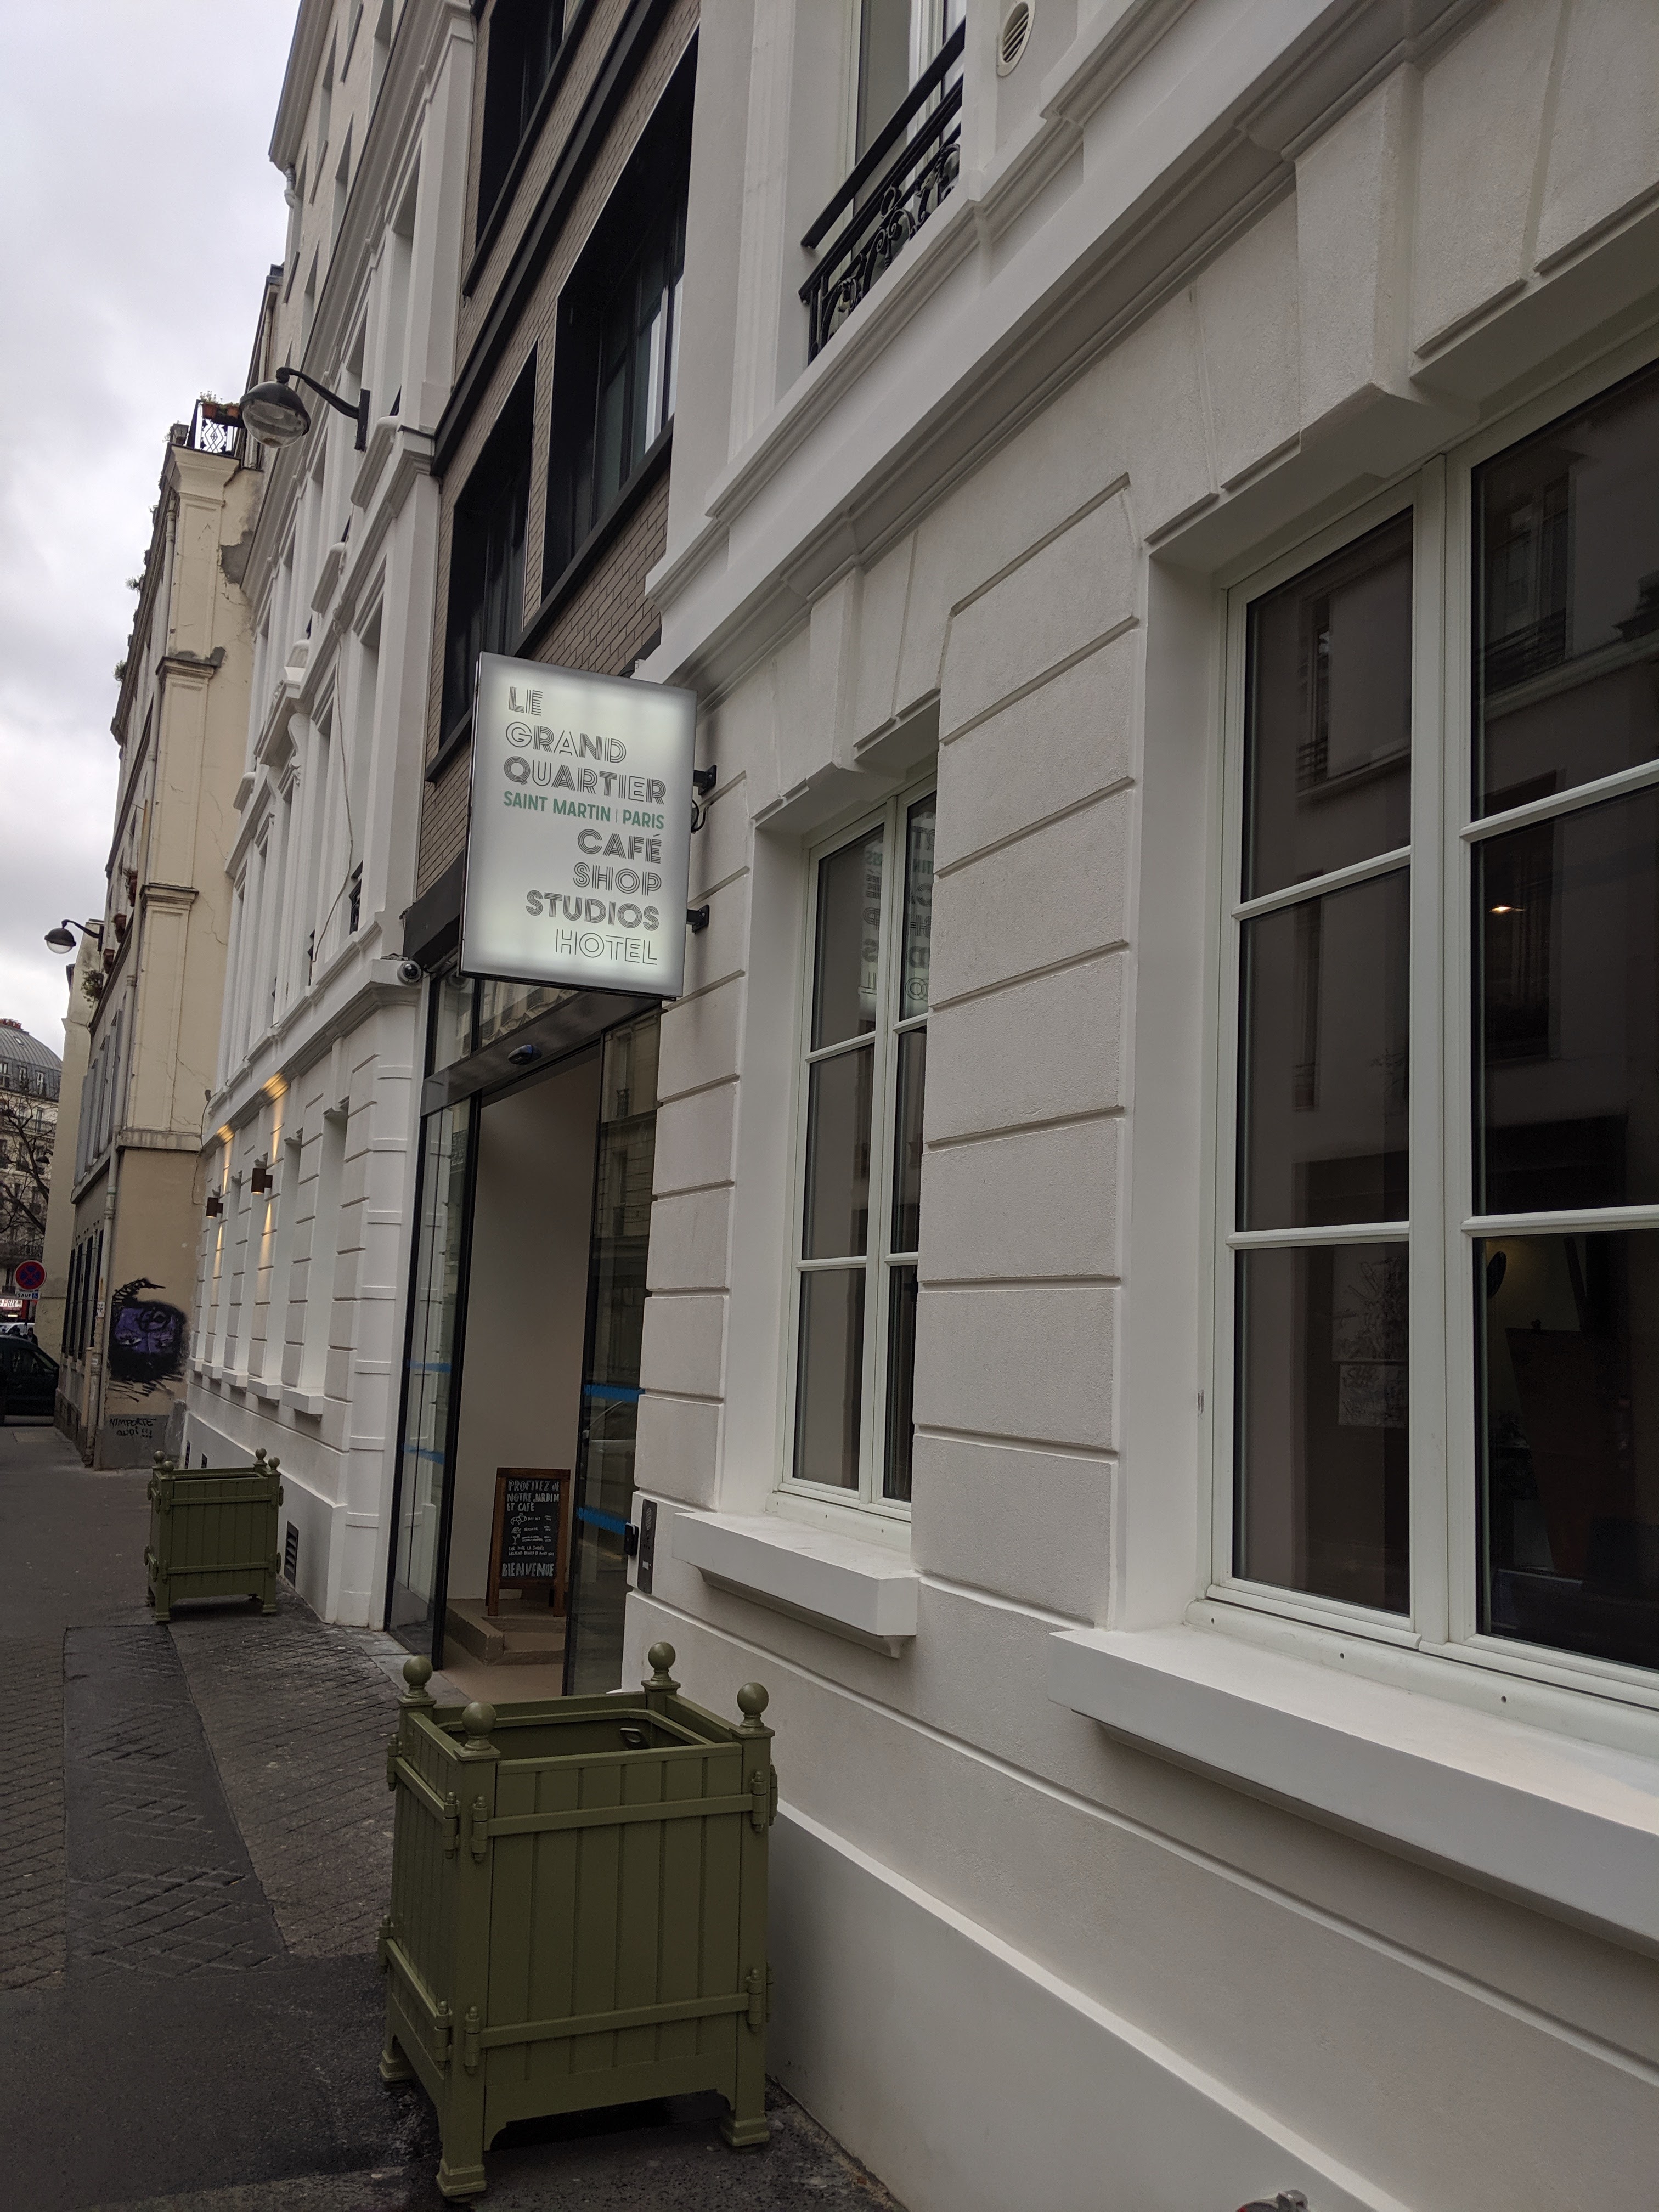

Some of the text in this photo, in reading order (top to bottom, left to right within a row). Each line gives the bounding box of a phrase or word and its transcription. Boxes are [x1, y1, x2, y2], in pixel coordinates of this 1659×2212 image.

[508, 686, 543, 716] LE
[505, 721, 627, 764] GRAND
[504, 755, 667, 806] QUARTIER
[503, 790, 665, 830] SAINT MARTIN PARIS
[577, 828, 662, 864] CAFÉ
[573, 861, 662, 896] SHOP
[526, 889, 660, 932] STUDIOS
[555, 928, 658, 966] HOTEL
[506, 1492, 560, 1503] NOTRE JARDIN
[508, 1480, 551, 1492] PROFITEZ
[506, 1503, 515, 1511] ET
[502, 1562, 554, 1577] BIENVENUE
